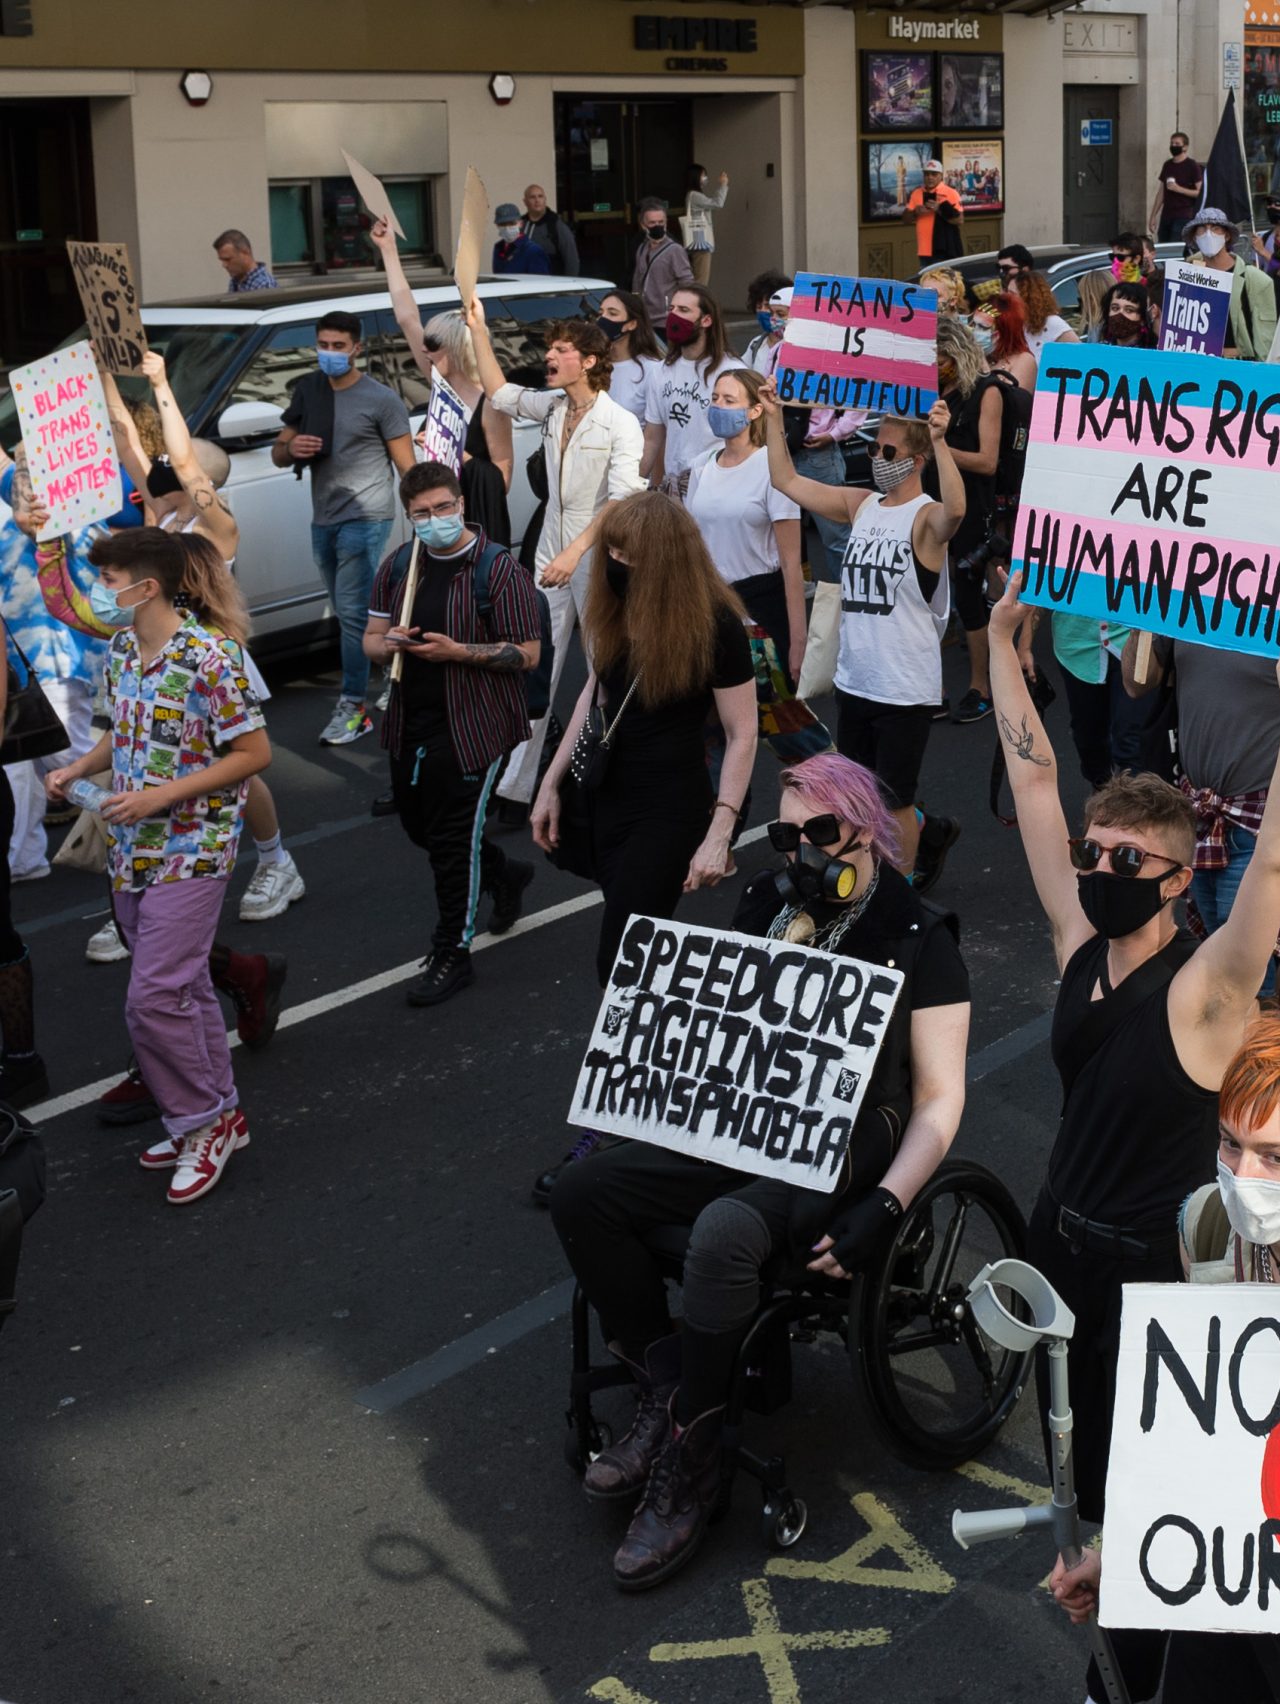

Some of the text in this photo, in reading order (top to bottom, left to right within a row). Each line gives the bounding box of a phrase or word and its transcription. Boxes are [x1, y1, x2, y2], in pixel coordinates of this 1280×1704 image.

[634, 15, 757, 52] EMPIRE
[889, 16, 980, 42] Haymarket
[1063, 22, 1126, 48] EXIT
[665, 57, 728, 71] CINEMAS
[811, 280, 917, 323] TRANS
[1195, 272, 1219, 288] Worker
[1167, 281, 1211, 335] Trans
[843, 327, 864, 358] IS
[33, 374, 88, 417] BLACK
[431, 384, 464, 442] Trans
[780, 367, 930, 419] BEAUTIFUL
[1045, 367, 1200, 454] TRANS
[37, 405, 91, 446] TRANS
[426, 415, 461, 477] Rights
[46, 457, 118, 507] MATTER
[1110, 462, 1212, 528] ARE
[842, 536, 911, 573] TRANS
[1020, 509, 1180, 622] HUMAN
[841, 566, 905, 612] ALLY
[611, 917, 899, 1047] SPEEDCORE
[620, 992, 845, 1107] AGAINST
[581, 1047, 853, 1177] TRANSPHOBIA
